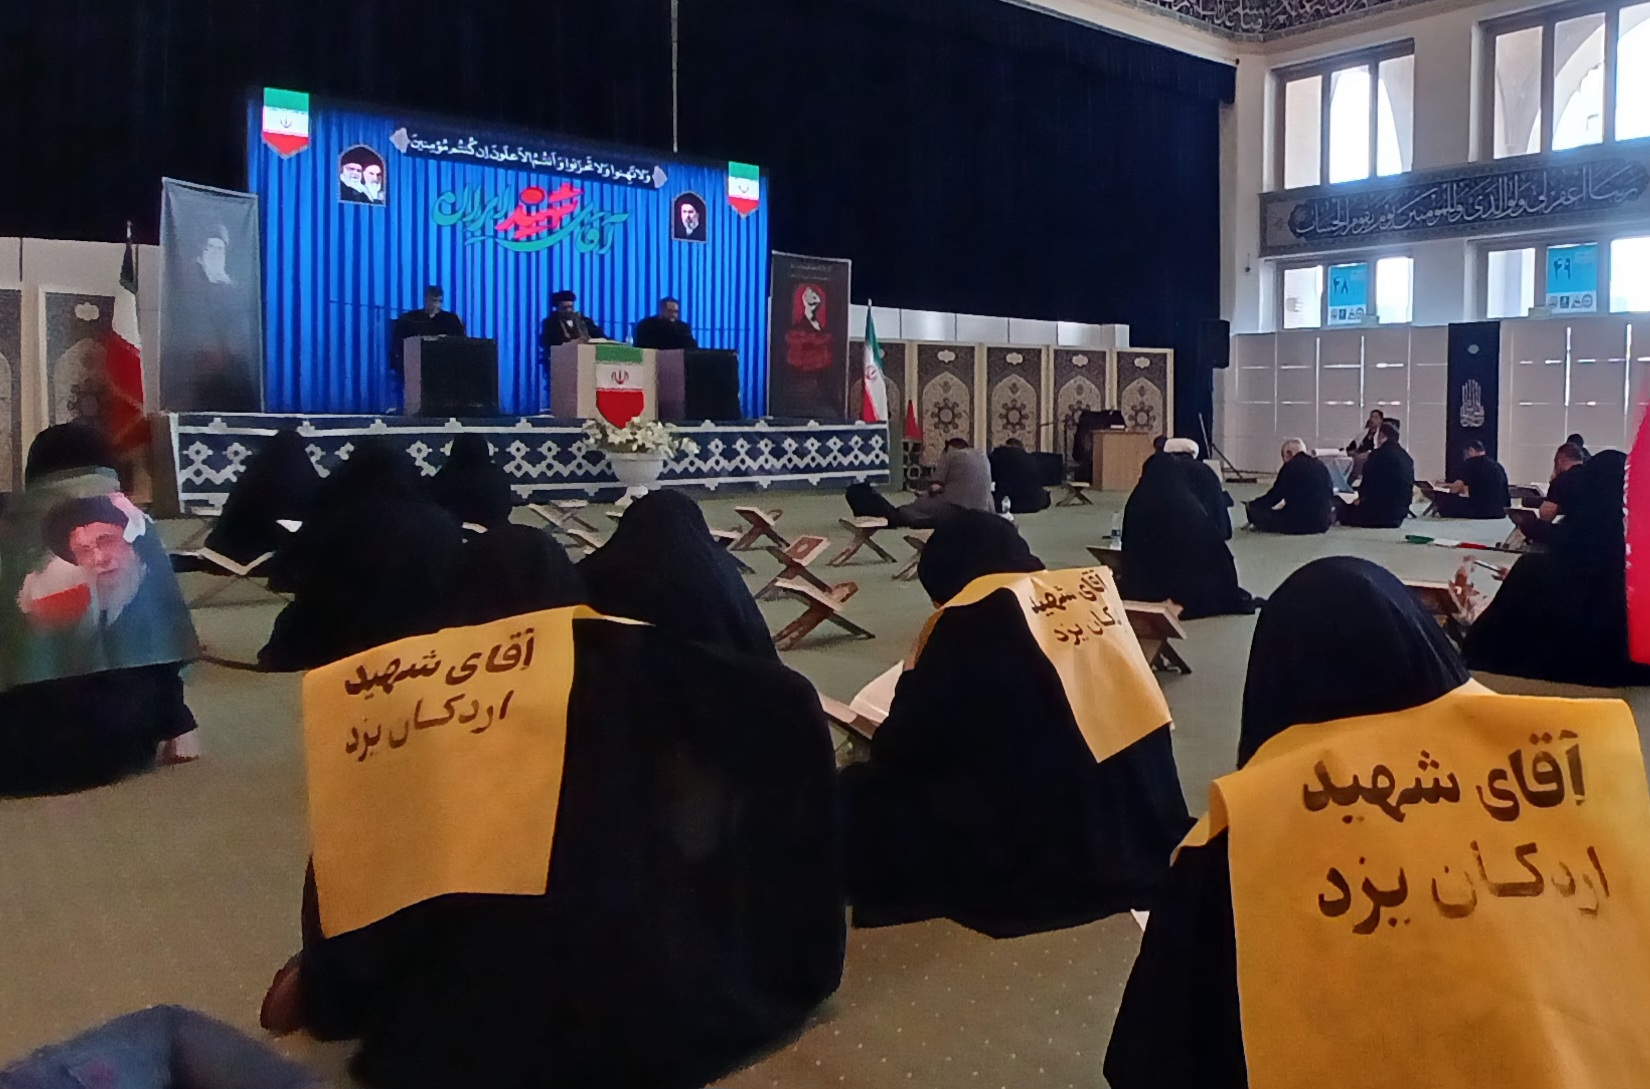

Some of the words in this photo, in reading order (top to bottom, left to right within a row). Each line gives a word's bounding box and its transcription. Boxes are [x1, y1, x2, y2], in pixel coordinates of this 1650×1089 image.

[495, 182, 585, 240] شهید
[1029, 585, 1077, 617] شهید
[1078, 570, 1108, 602] آقای
[445, 627, 535, 686] آقای
[1054, 623, 1089, 646] یزد
[344, 649, 442, 700] شهید
[345, 715, 382, 762] یزد
[389, 689, 515, 749] اردکان
[1302, 750, 1461, 824] شهید
[1475, 729, 1586, 823] آقای
[1318, 856, 1411, 936] یزد
[1431, 840, 1610, 920] اردکان
